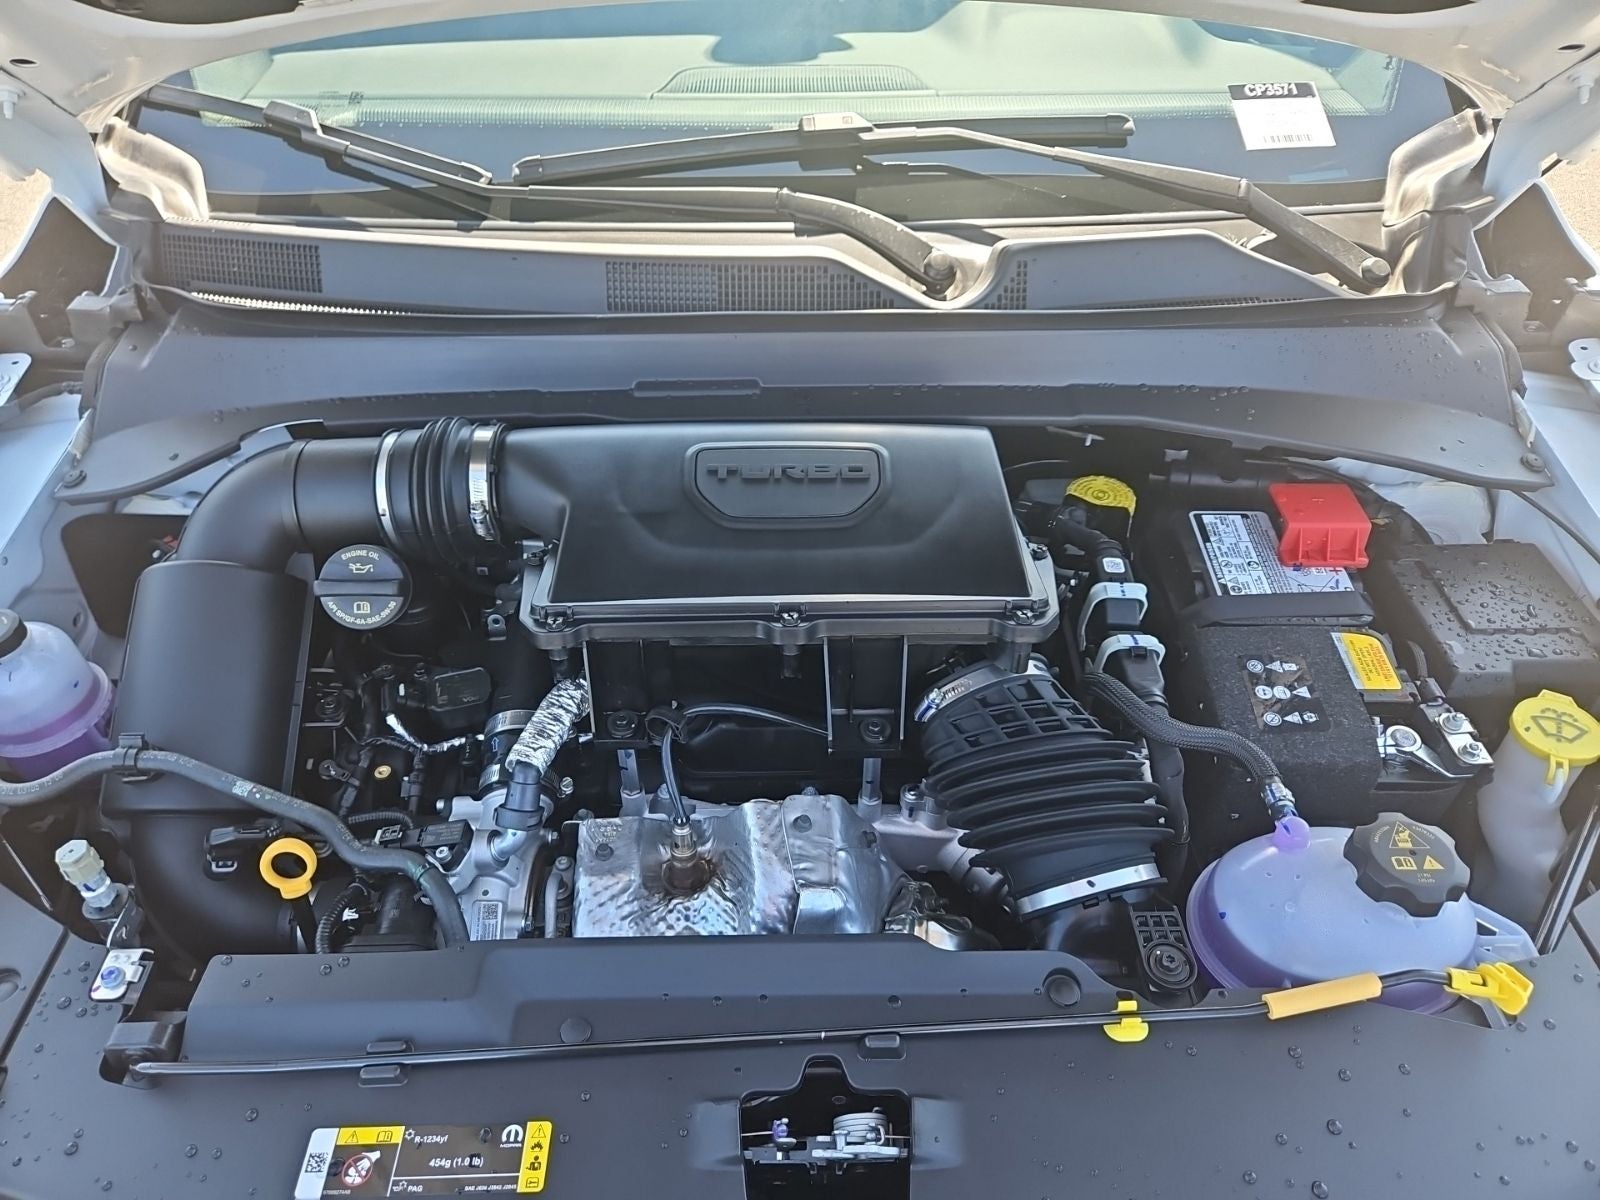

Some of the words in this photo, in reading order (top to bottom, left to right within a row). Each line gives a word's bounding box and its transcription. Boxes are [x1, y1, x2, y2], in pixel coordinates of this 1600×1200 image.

[1243, 83, 1298, 97] CP3571
[706, 463, 871, 480] TURBO
[341, 549, 367, 561] ENGINE
[368, 550, 380, 561] OIL
[327, 601, 337, 613] API
[414, 1134, 449, 1145] R-1234yf
[428, 1158, 452, 1168] 454g
[453, 1157, 469, 1168] (1.0
[471, 1156, 484, 1168] lb)
